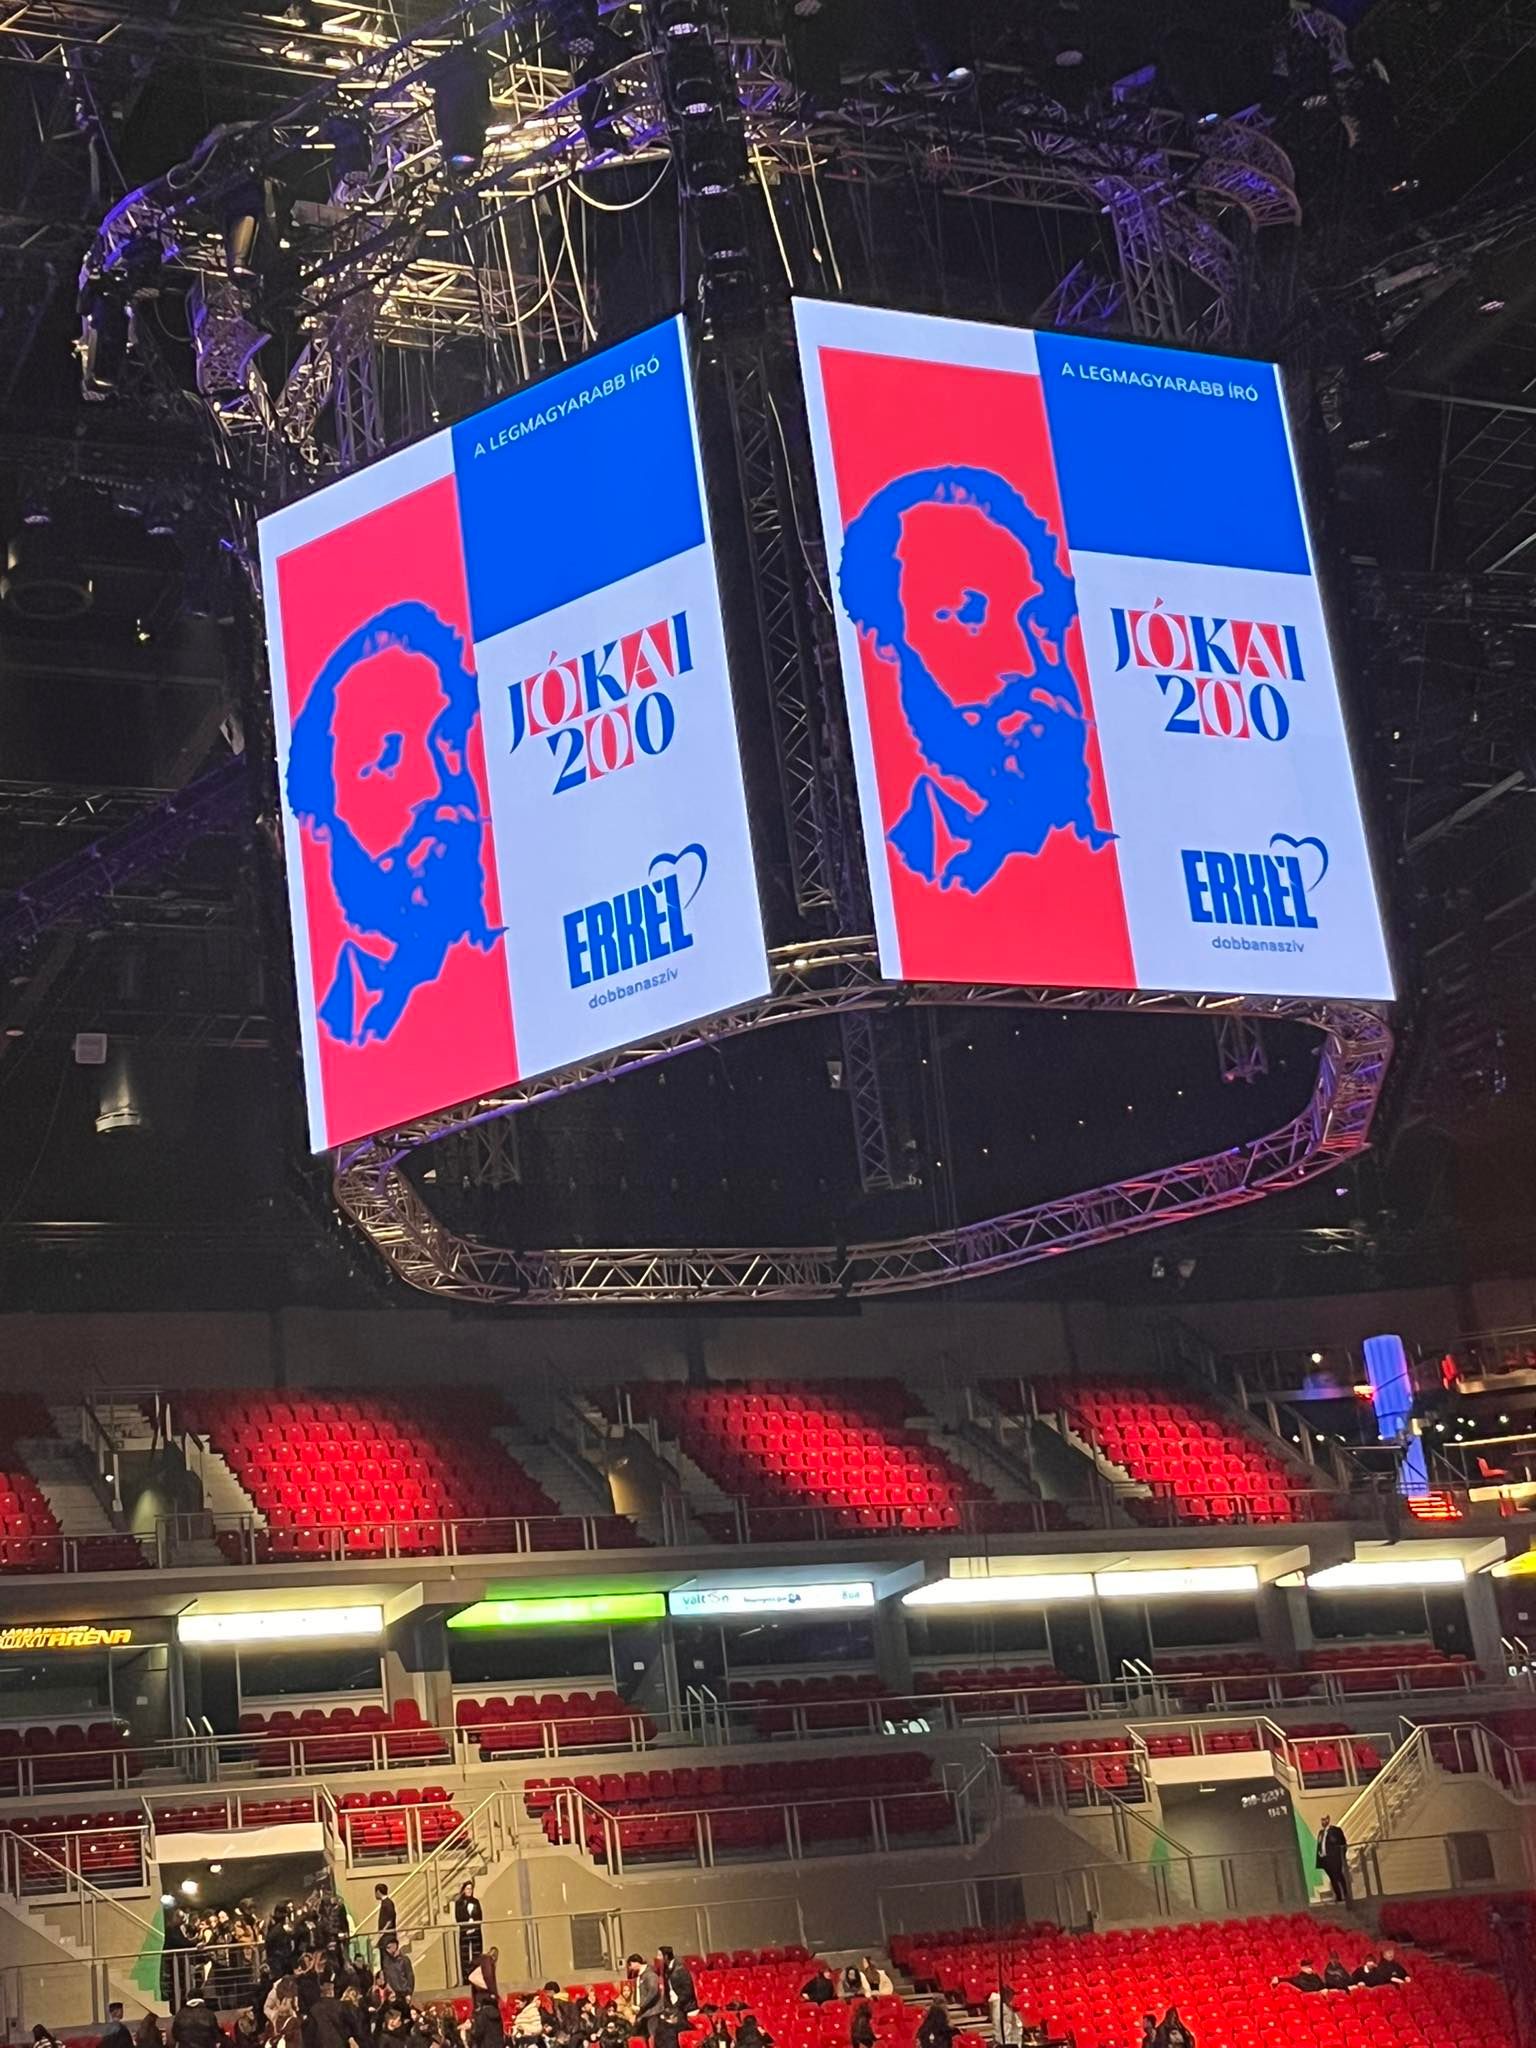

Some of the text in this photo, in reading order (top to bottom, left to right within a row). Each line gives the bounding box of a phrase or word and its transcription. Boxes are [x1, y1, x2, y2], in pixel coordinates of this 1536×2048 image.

[473, 354, 660, 459] A LEGMAGYARABB ÍRÓ
[1061, 362, 1259, 402] A LEGMAGYARABB ÍRÓ
[507, 610, 694, 754] JÓKAI
[1109, 597, 1306, 682] JÓKAI
[546, 692, 675, 795] 200
[1155, 674, 1290, 742] 200
[563, 874, 694, 989] ERKEL
[1181, 849, 1319, 929] ERKEL
[588, 967, 679, 1009] dobbanaszív
